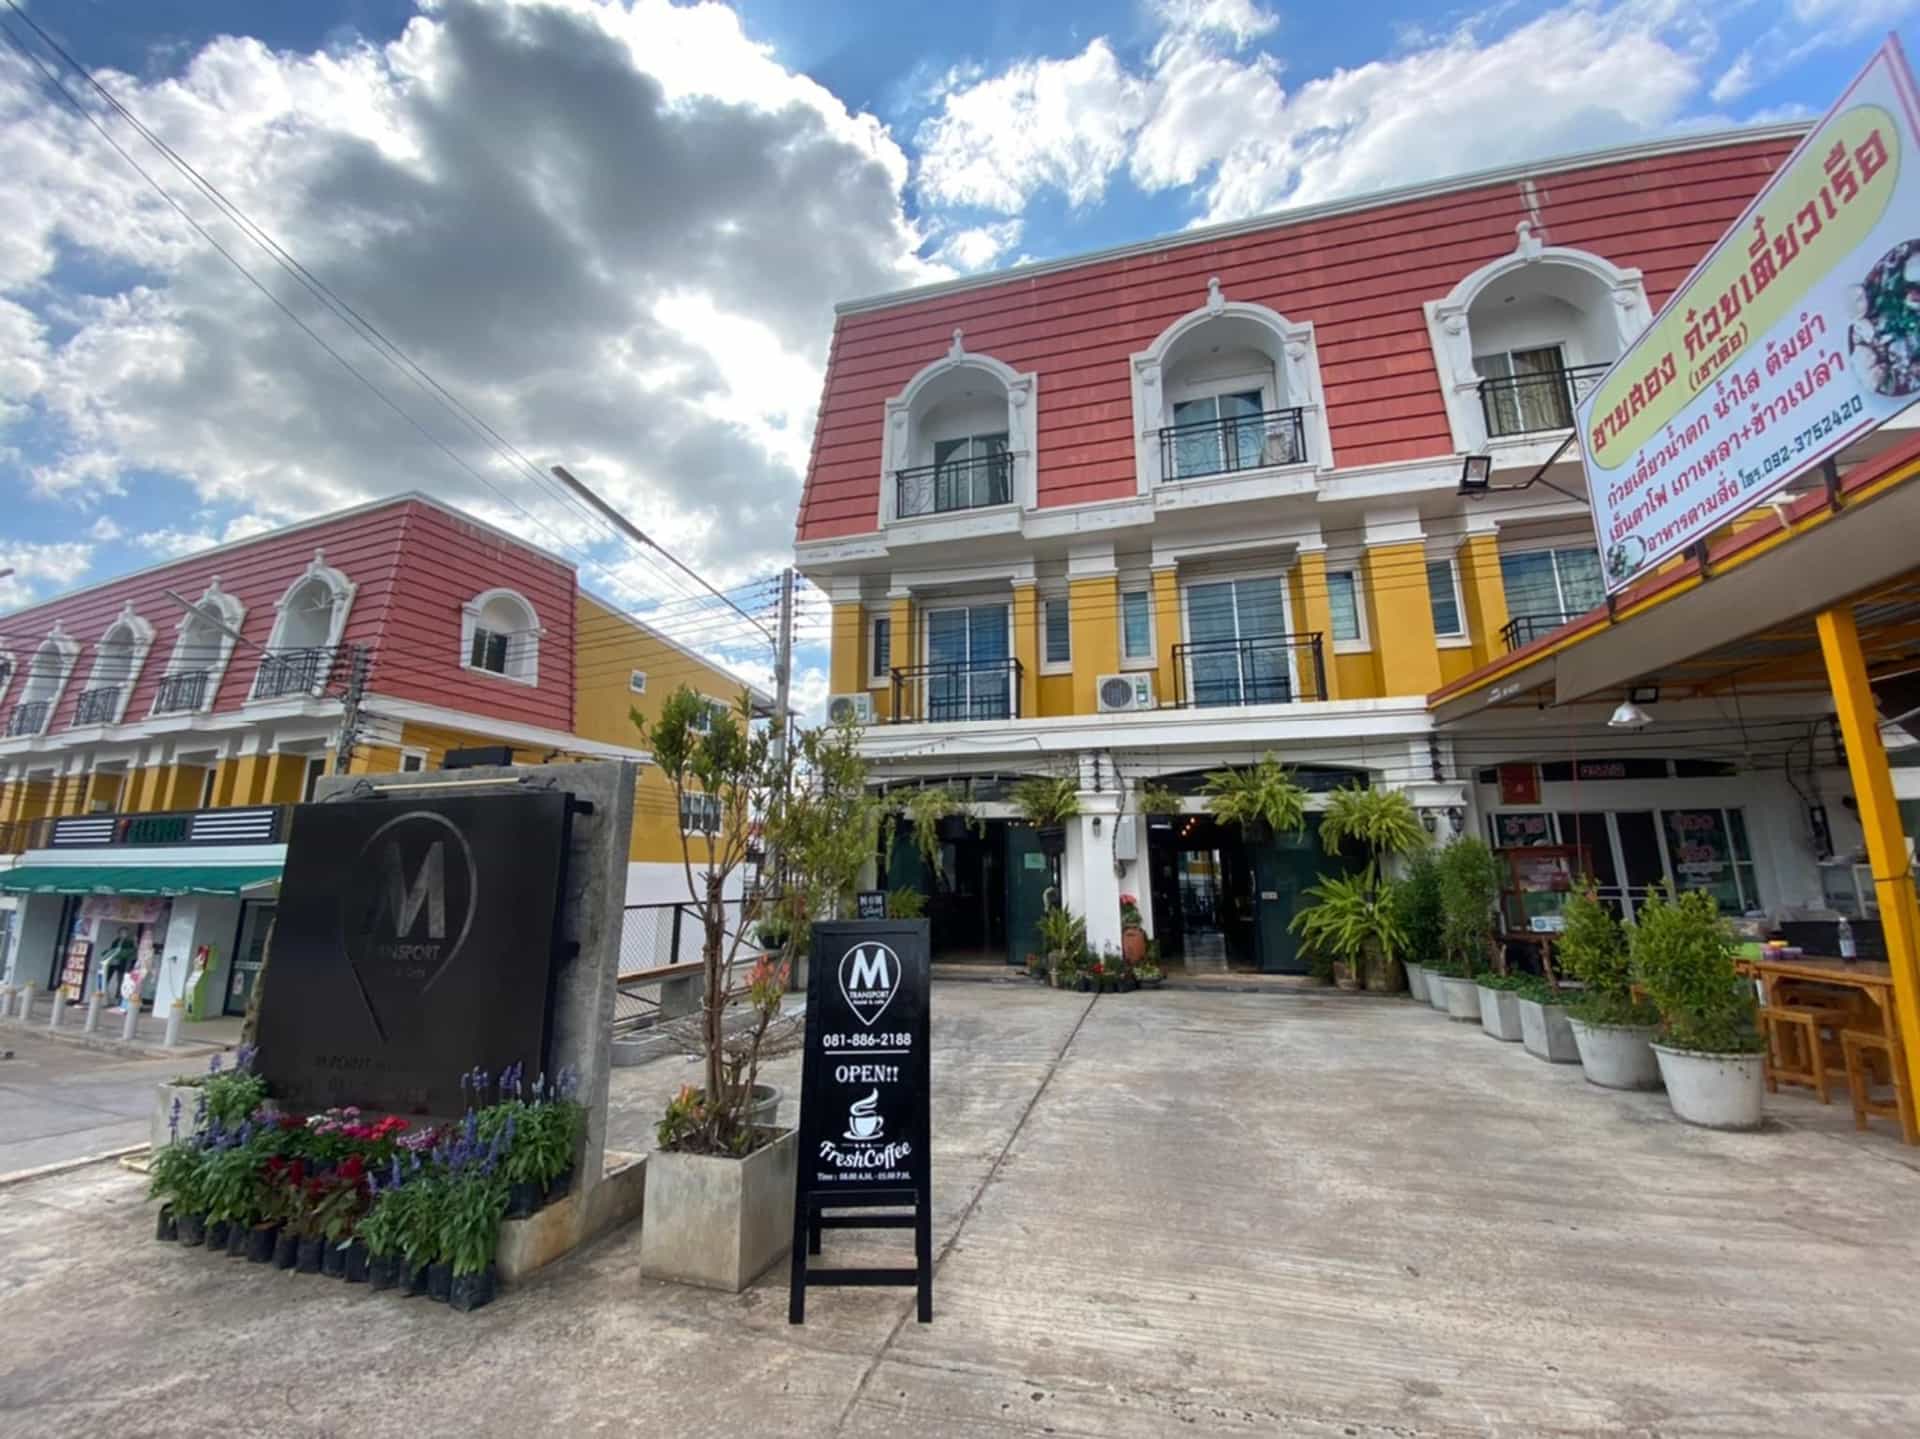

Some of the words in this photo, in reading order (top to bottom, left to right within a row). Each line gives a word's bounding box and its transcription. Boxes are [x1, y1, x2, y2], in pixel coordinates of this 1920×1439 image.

[1683, 129, 1888, 361] ก๋วยเตี๋ยวเรือ
[1607, 411, 1710, 509] ก๋วยเตี๋ยวน้ำตก
[1713, 368, 1761, 420] น้ำใส
[1764, 311, 1826, 377] ต้มยำ
[1608, 484, 1668, 542] เย็นตาโฟ
[1671, 349, 1845, 497] เกาเหลา+ข้าวเปล่า
[1646, 470, 1739, 551] อาหารตามสั่ง
[849, 948, 890, 989] M
[849, 991, 889, 999] TRANSPORT
[823, 1032, 912, 1047] 081-886-2188
[835, 1064, 899, 1082] OPEN!!
